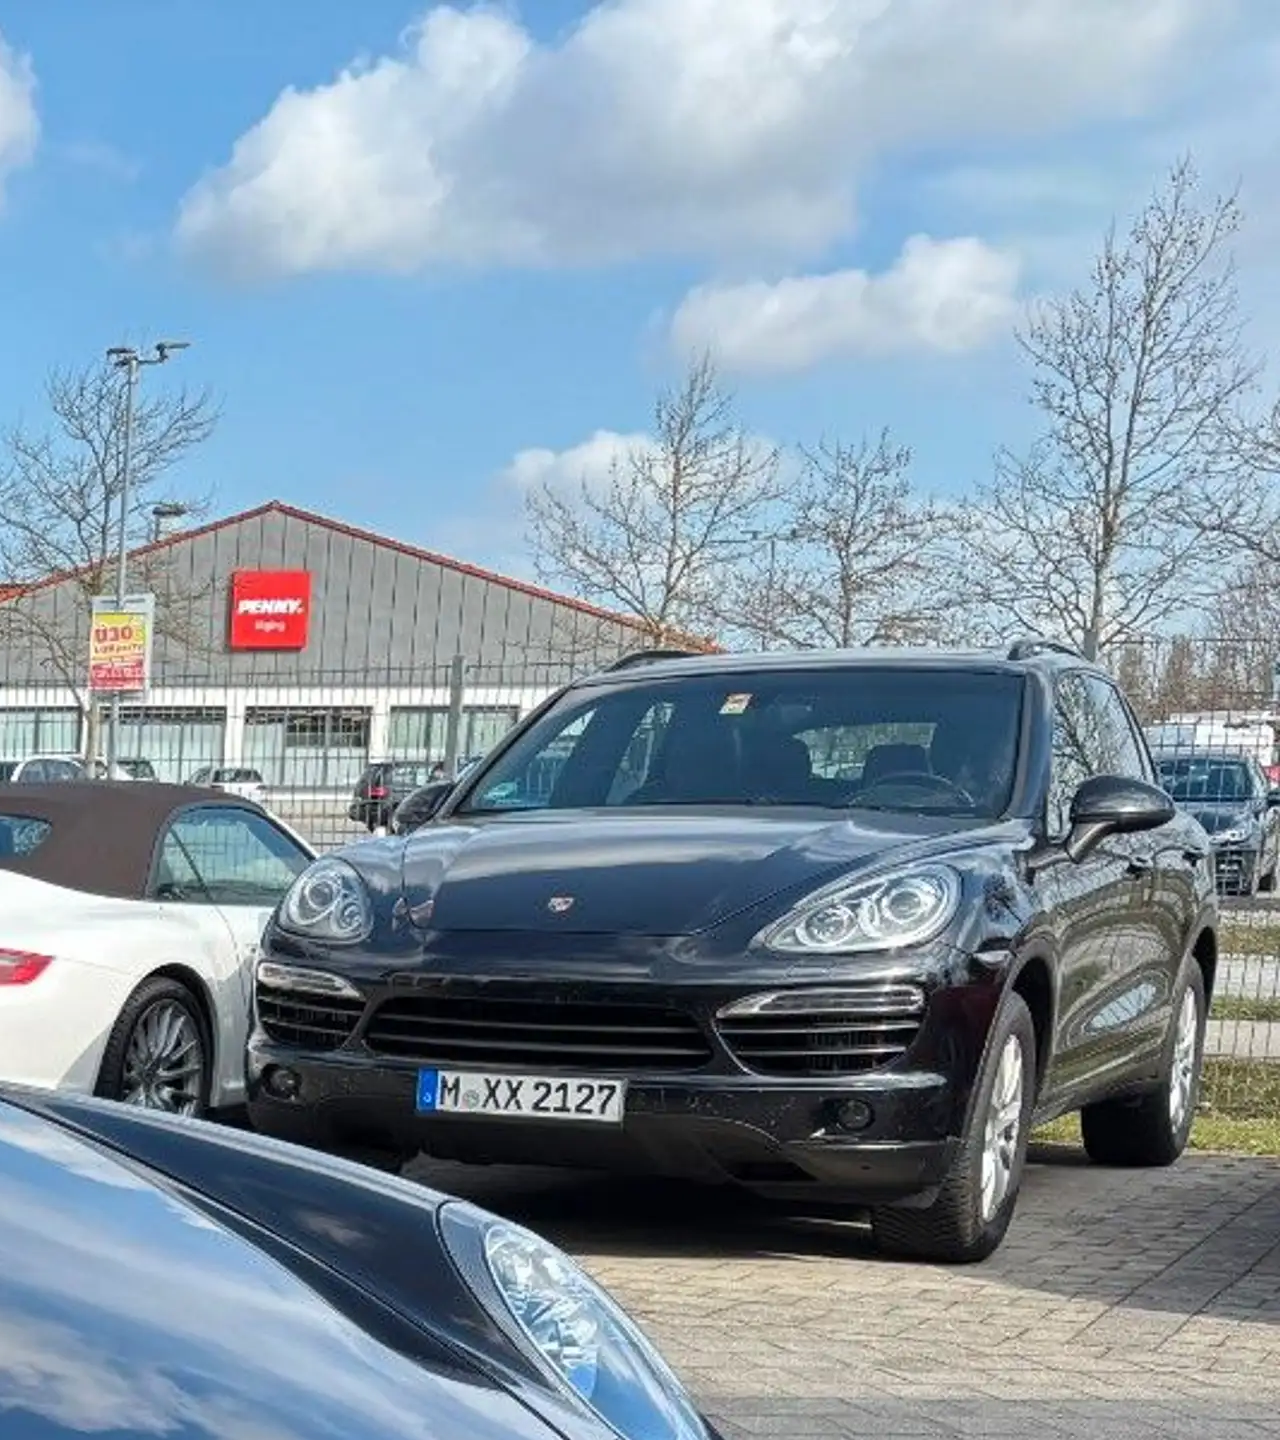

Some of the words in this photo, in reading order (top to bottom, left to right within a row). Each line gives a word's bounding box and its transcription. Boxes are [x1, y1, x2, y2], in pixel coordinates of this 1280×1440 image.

[440, 1075, 461, 1107] M
[482, 1077, 524, 1111] XX
[531, 1082, 618, 1115] 2127
